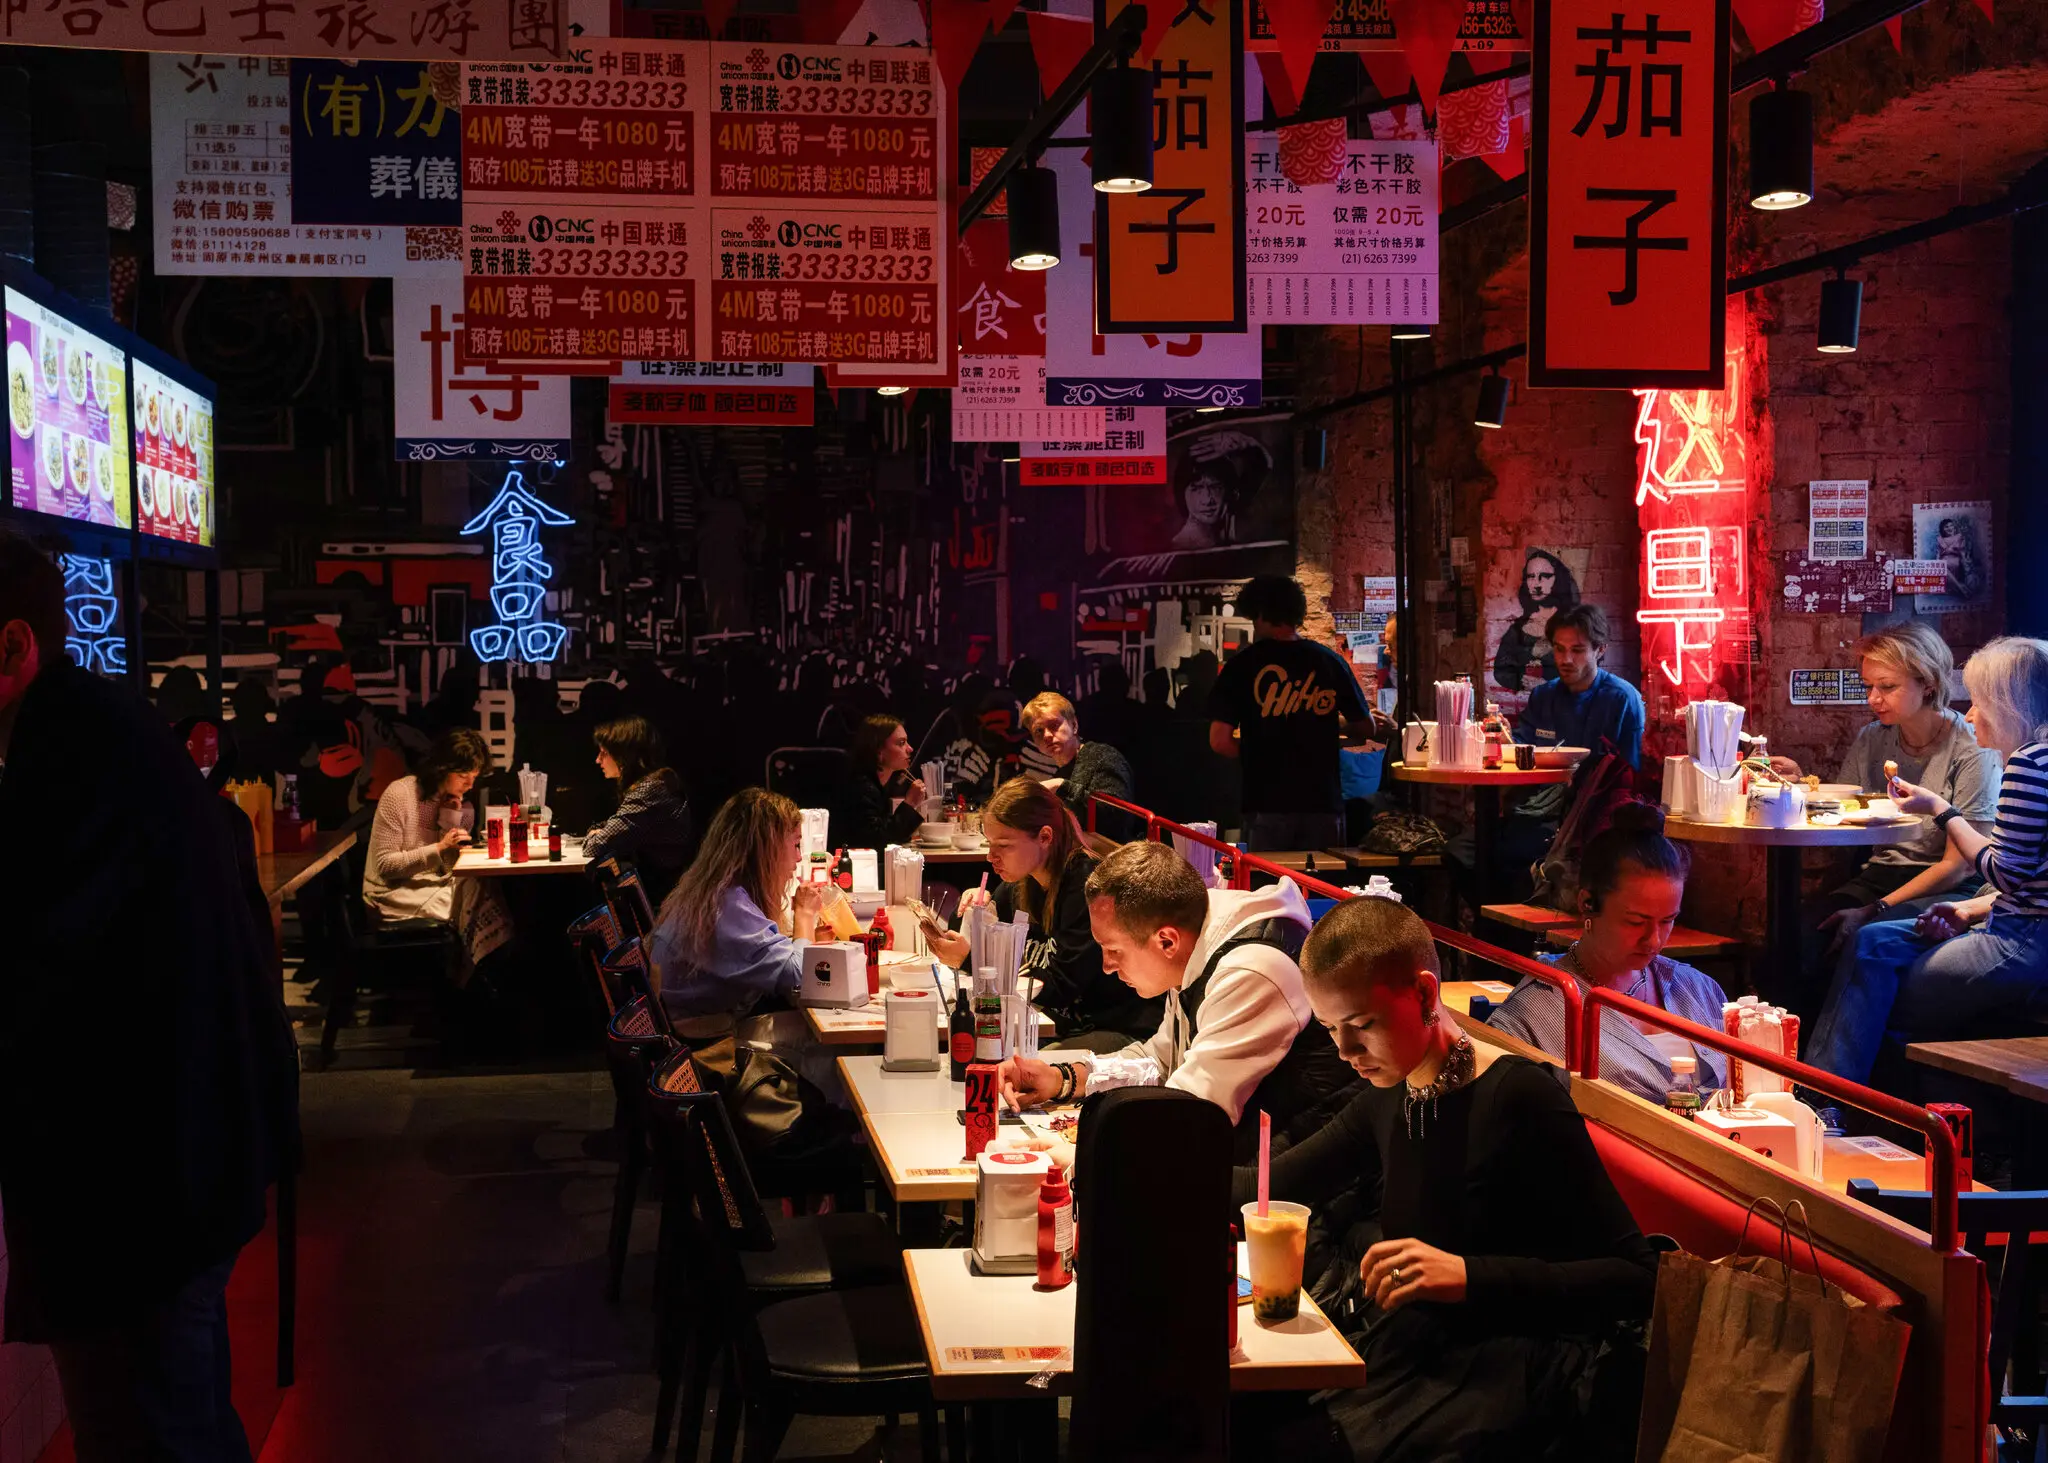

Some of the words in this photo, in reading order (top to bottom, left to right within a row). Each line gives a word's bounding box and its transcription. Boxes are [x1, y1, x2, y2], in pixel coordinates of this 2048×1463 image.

[599, 52, 686, 77] 中国联通
[848, 59, 931, 84] 中国联通
[1346, 154, 1415, 174] 不干胶
[1571, 13, 1691, 306] 茄子
[369, 155, 458, 200] 葬儀
[1337, 178, 1422, 195] 彩色不干胶
[173, 199, 275, 221] 微信购票
[1257, 205, 1305, 226] 20元
[1333, 206, 1368, 224] 仅需
[1376, 206, 1424, 226] 20元
[601, 220, 687, 245] 中国联通
[848, 225, 932, 250] 中国联通
[1334, 237, 1425, 249] 其他尺寸价格另算
[1273, 253, 1298, 264] 7399
[1342, 253, 1361, 265] (21)
[1363, 253, 1389, 264] 6263
[1392, 253, 1417, 264] 7399
[960, 366, 984, 379] 仅需
[989, 366, 1020, 380] 20元
[966, 1073, 995, 1113] 24
